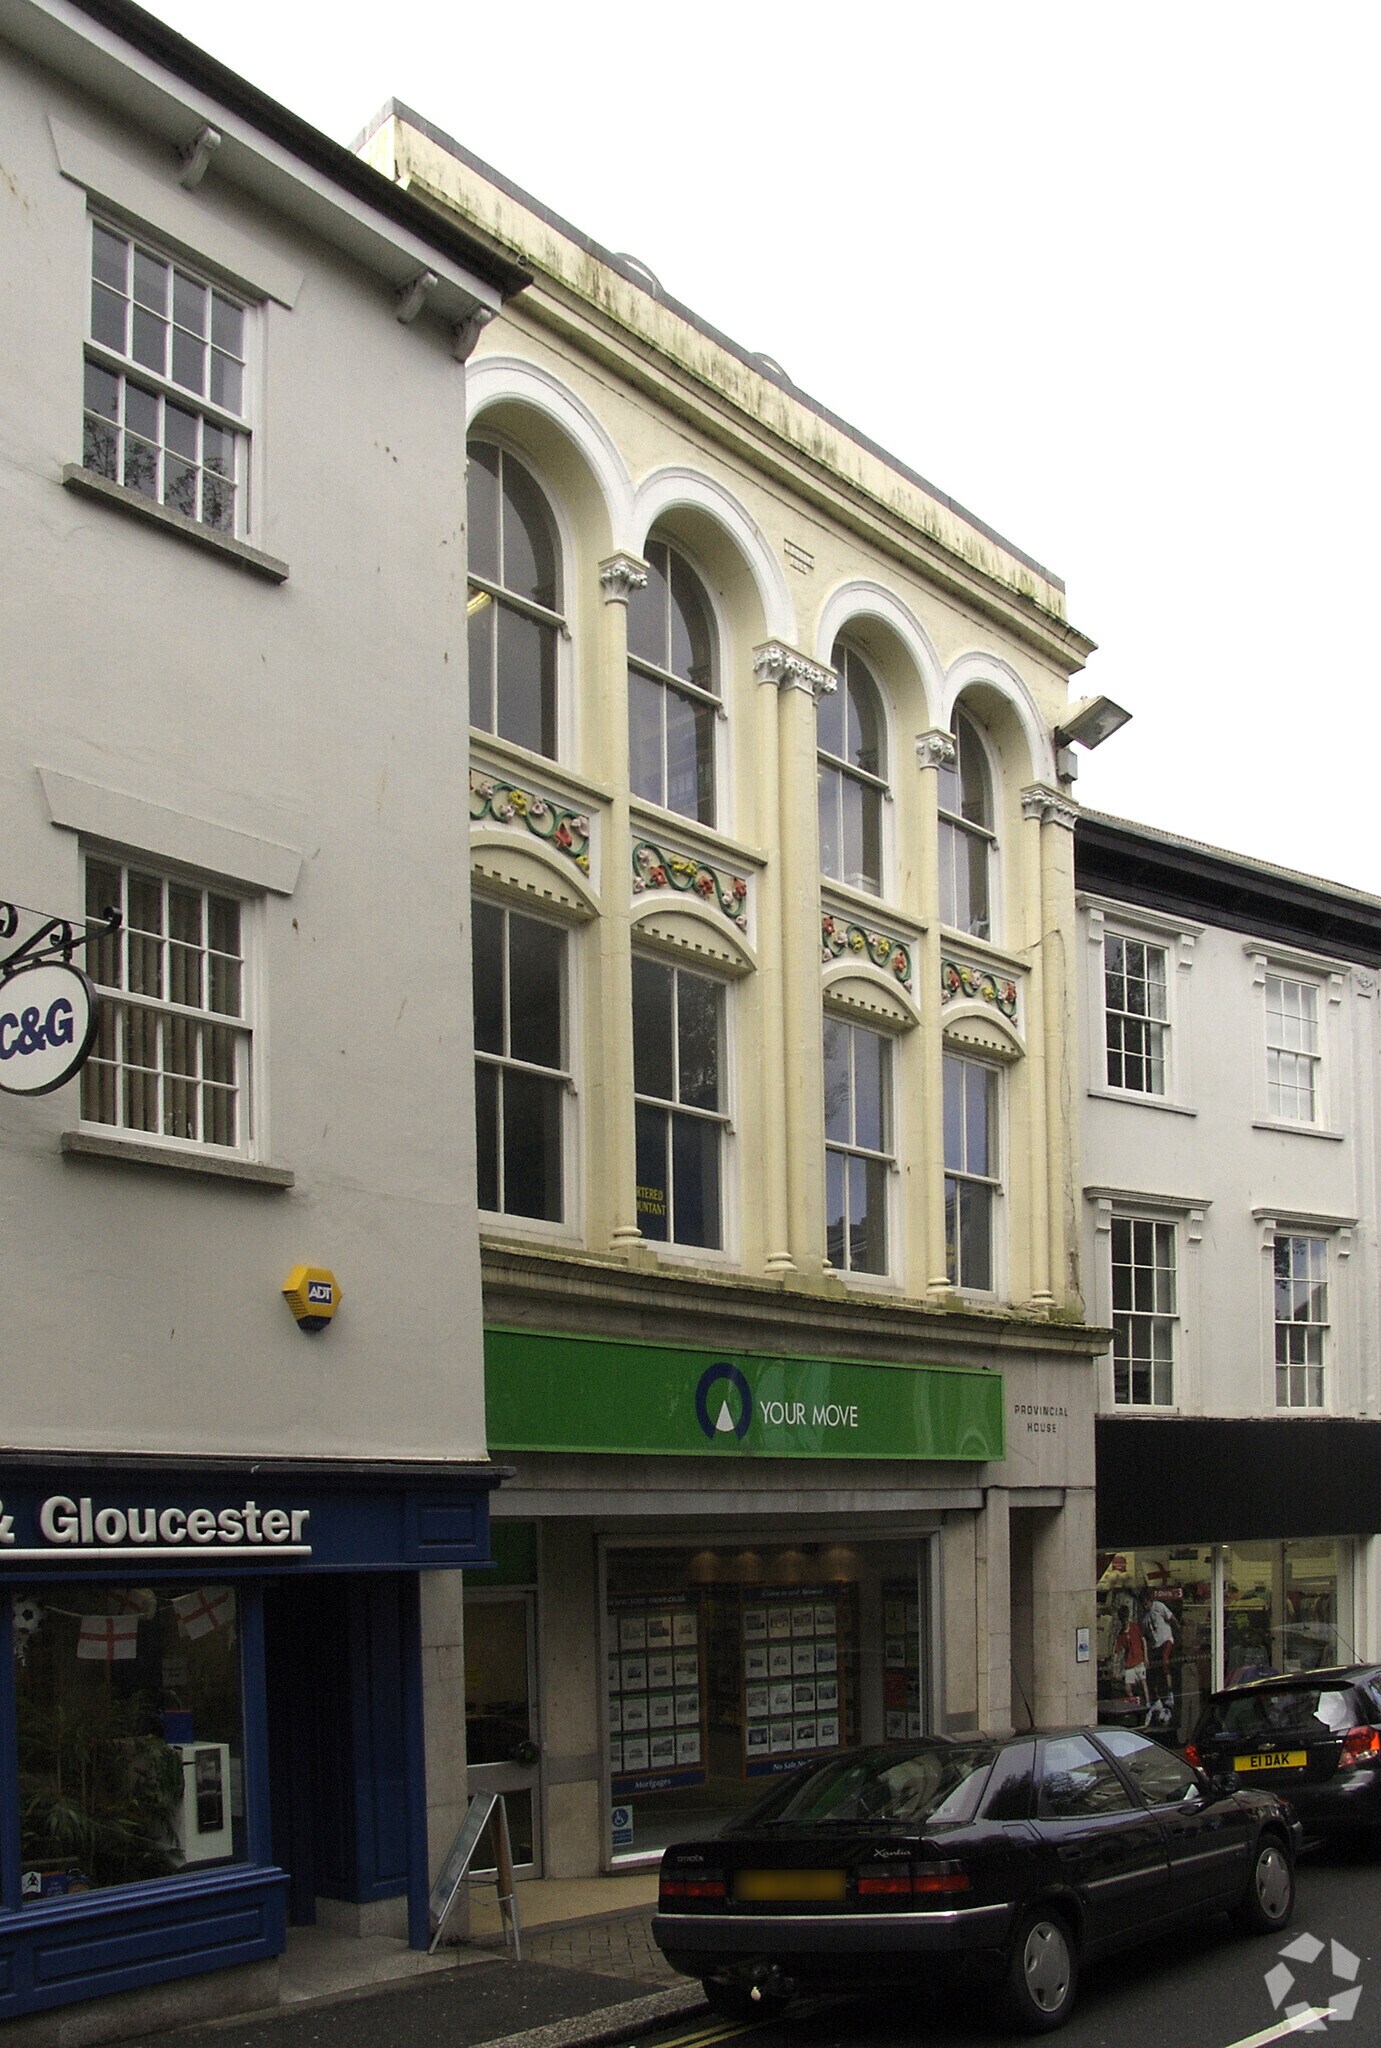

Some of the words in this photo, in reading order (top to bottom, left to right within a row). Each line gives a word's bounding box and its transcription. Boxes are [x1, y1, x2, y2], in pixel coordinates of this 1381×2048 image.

[0, 998, 73, 1060] C&G
[308, 1286, 332, 1300] ADT
[760, 1401, 806, 1425] YOUR
[812, 1404, 858, 1427] MOVE
[1014, 1404, 1068, 1417] PROVINCIAL
[1027, 1422, 1056, 1433] HOUSE
[40, 1495, 310, 1543] Gloucester
[1265, 1753, 1289, 1766] DAK
[634, 1779, 671, 1789] Mortgages
[873, 1848, 911, 1858] Xantia
